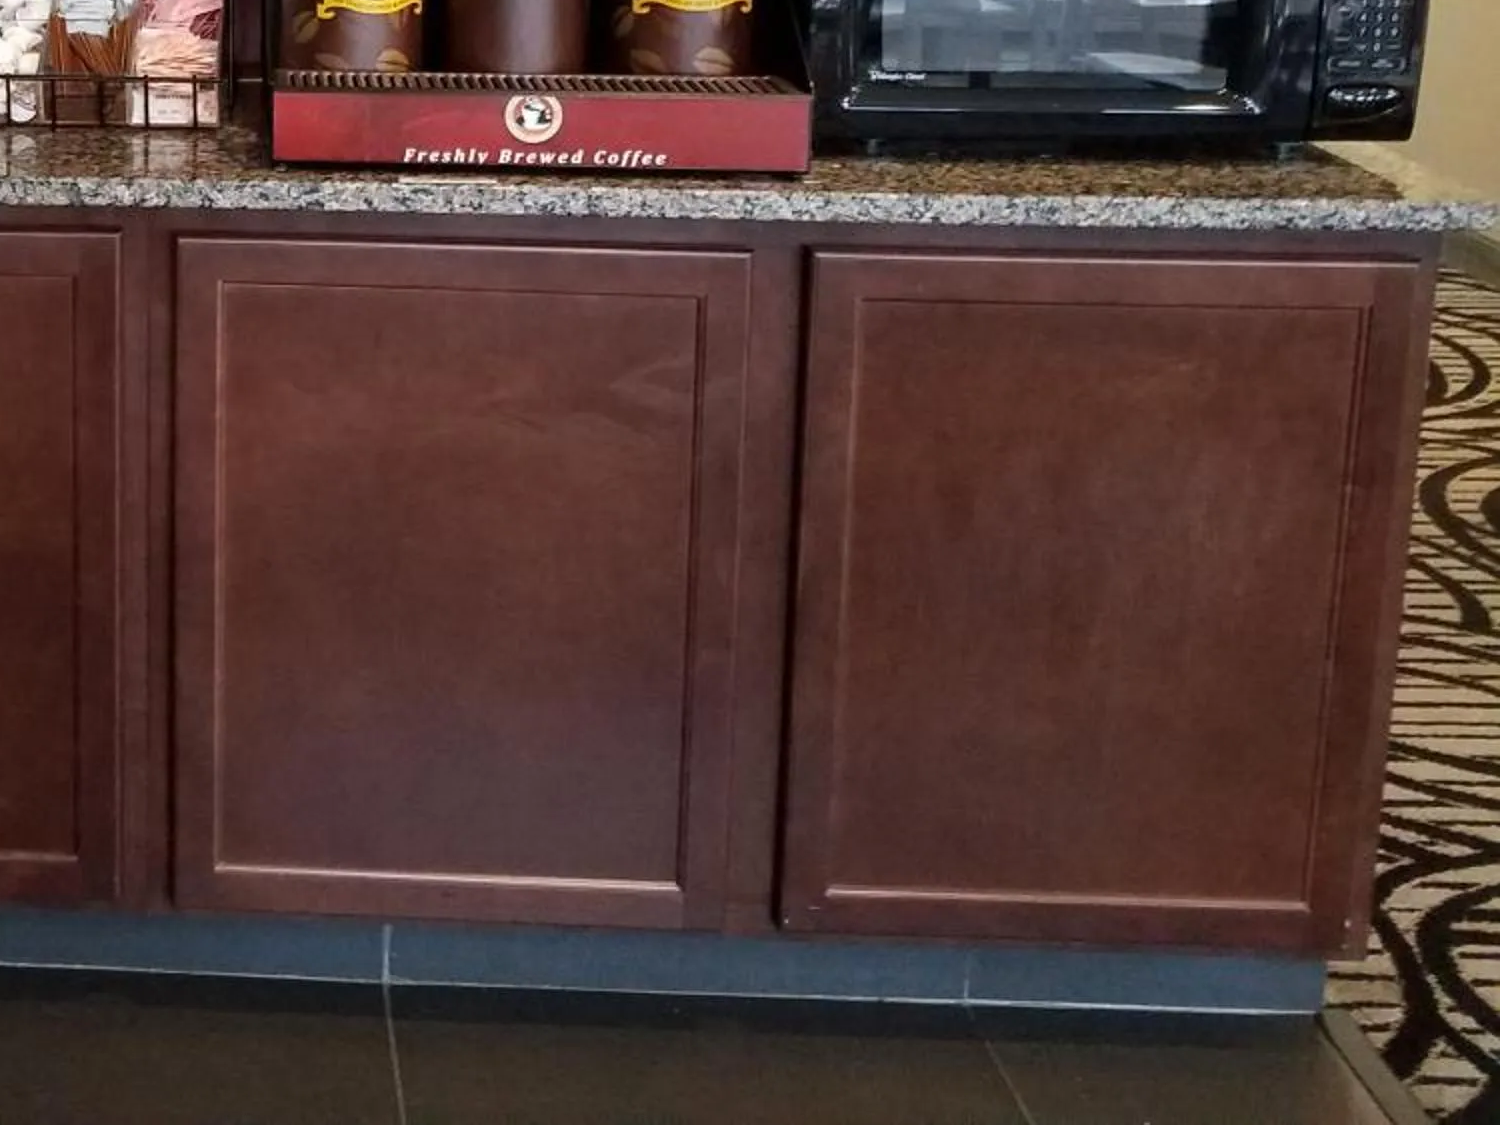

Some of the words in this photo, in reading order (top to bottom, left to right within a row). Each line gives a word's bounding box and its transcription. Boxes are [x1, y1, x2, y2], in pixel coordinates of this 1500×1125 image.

[403, 147, 490, 165] Freshly
[497, 148, 585, 166] Brewed
[593, 149, 670, 168] Coffee
